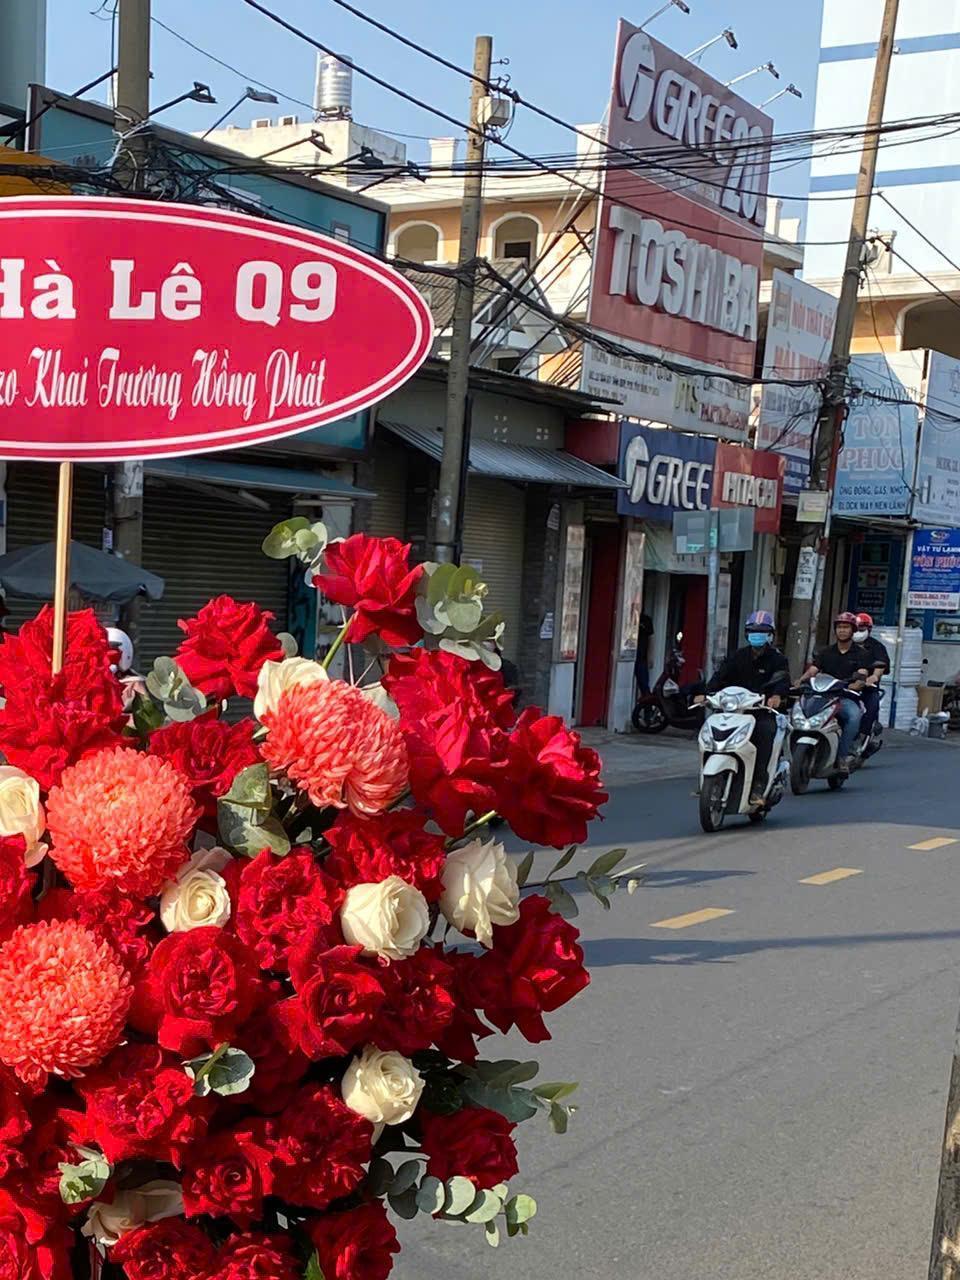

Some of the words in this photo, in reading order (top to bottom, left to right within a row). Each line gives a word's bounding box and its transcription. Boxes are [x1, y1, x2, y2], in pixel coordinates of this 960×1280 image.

[655, 70, 736, 165] GREE
[109, 259, 202, 320] Lê
[235, 261, 337, 327] Q9
[609, 205, 758, 342] TOSHIBA
[25, 347, 89, 407] Khai
[98, 347, 183, 421] Trương
[191, 349, 257, 421] Hồng
[265, 349, 326, 419] Phát
[647, 455, 713, 511] GREE
